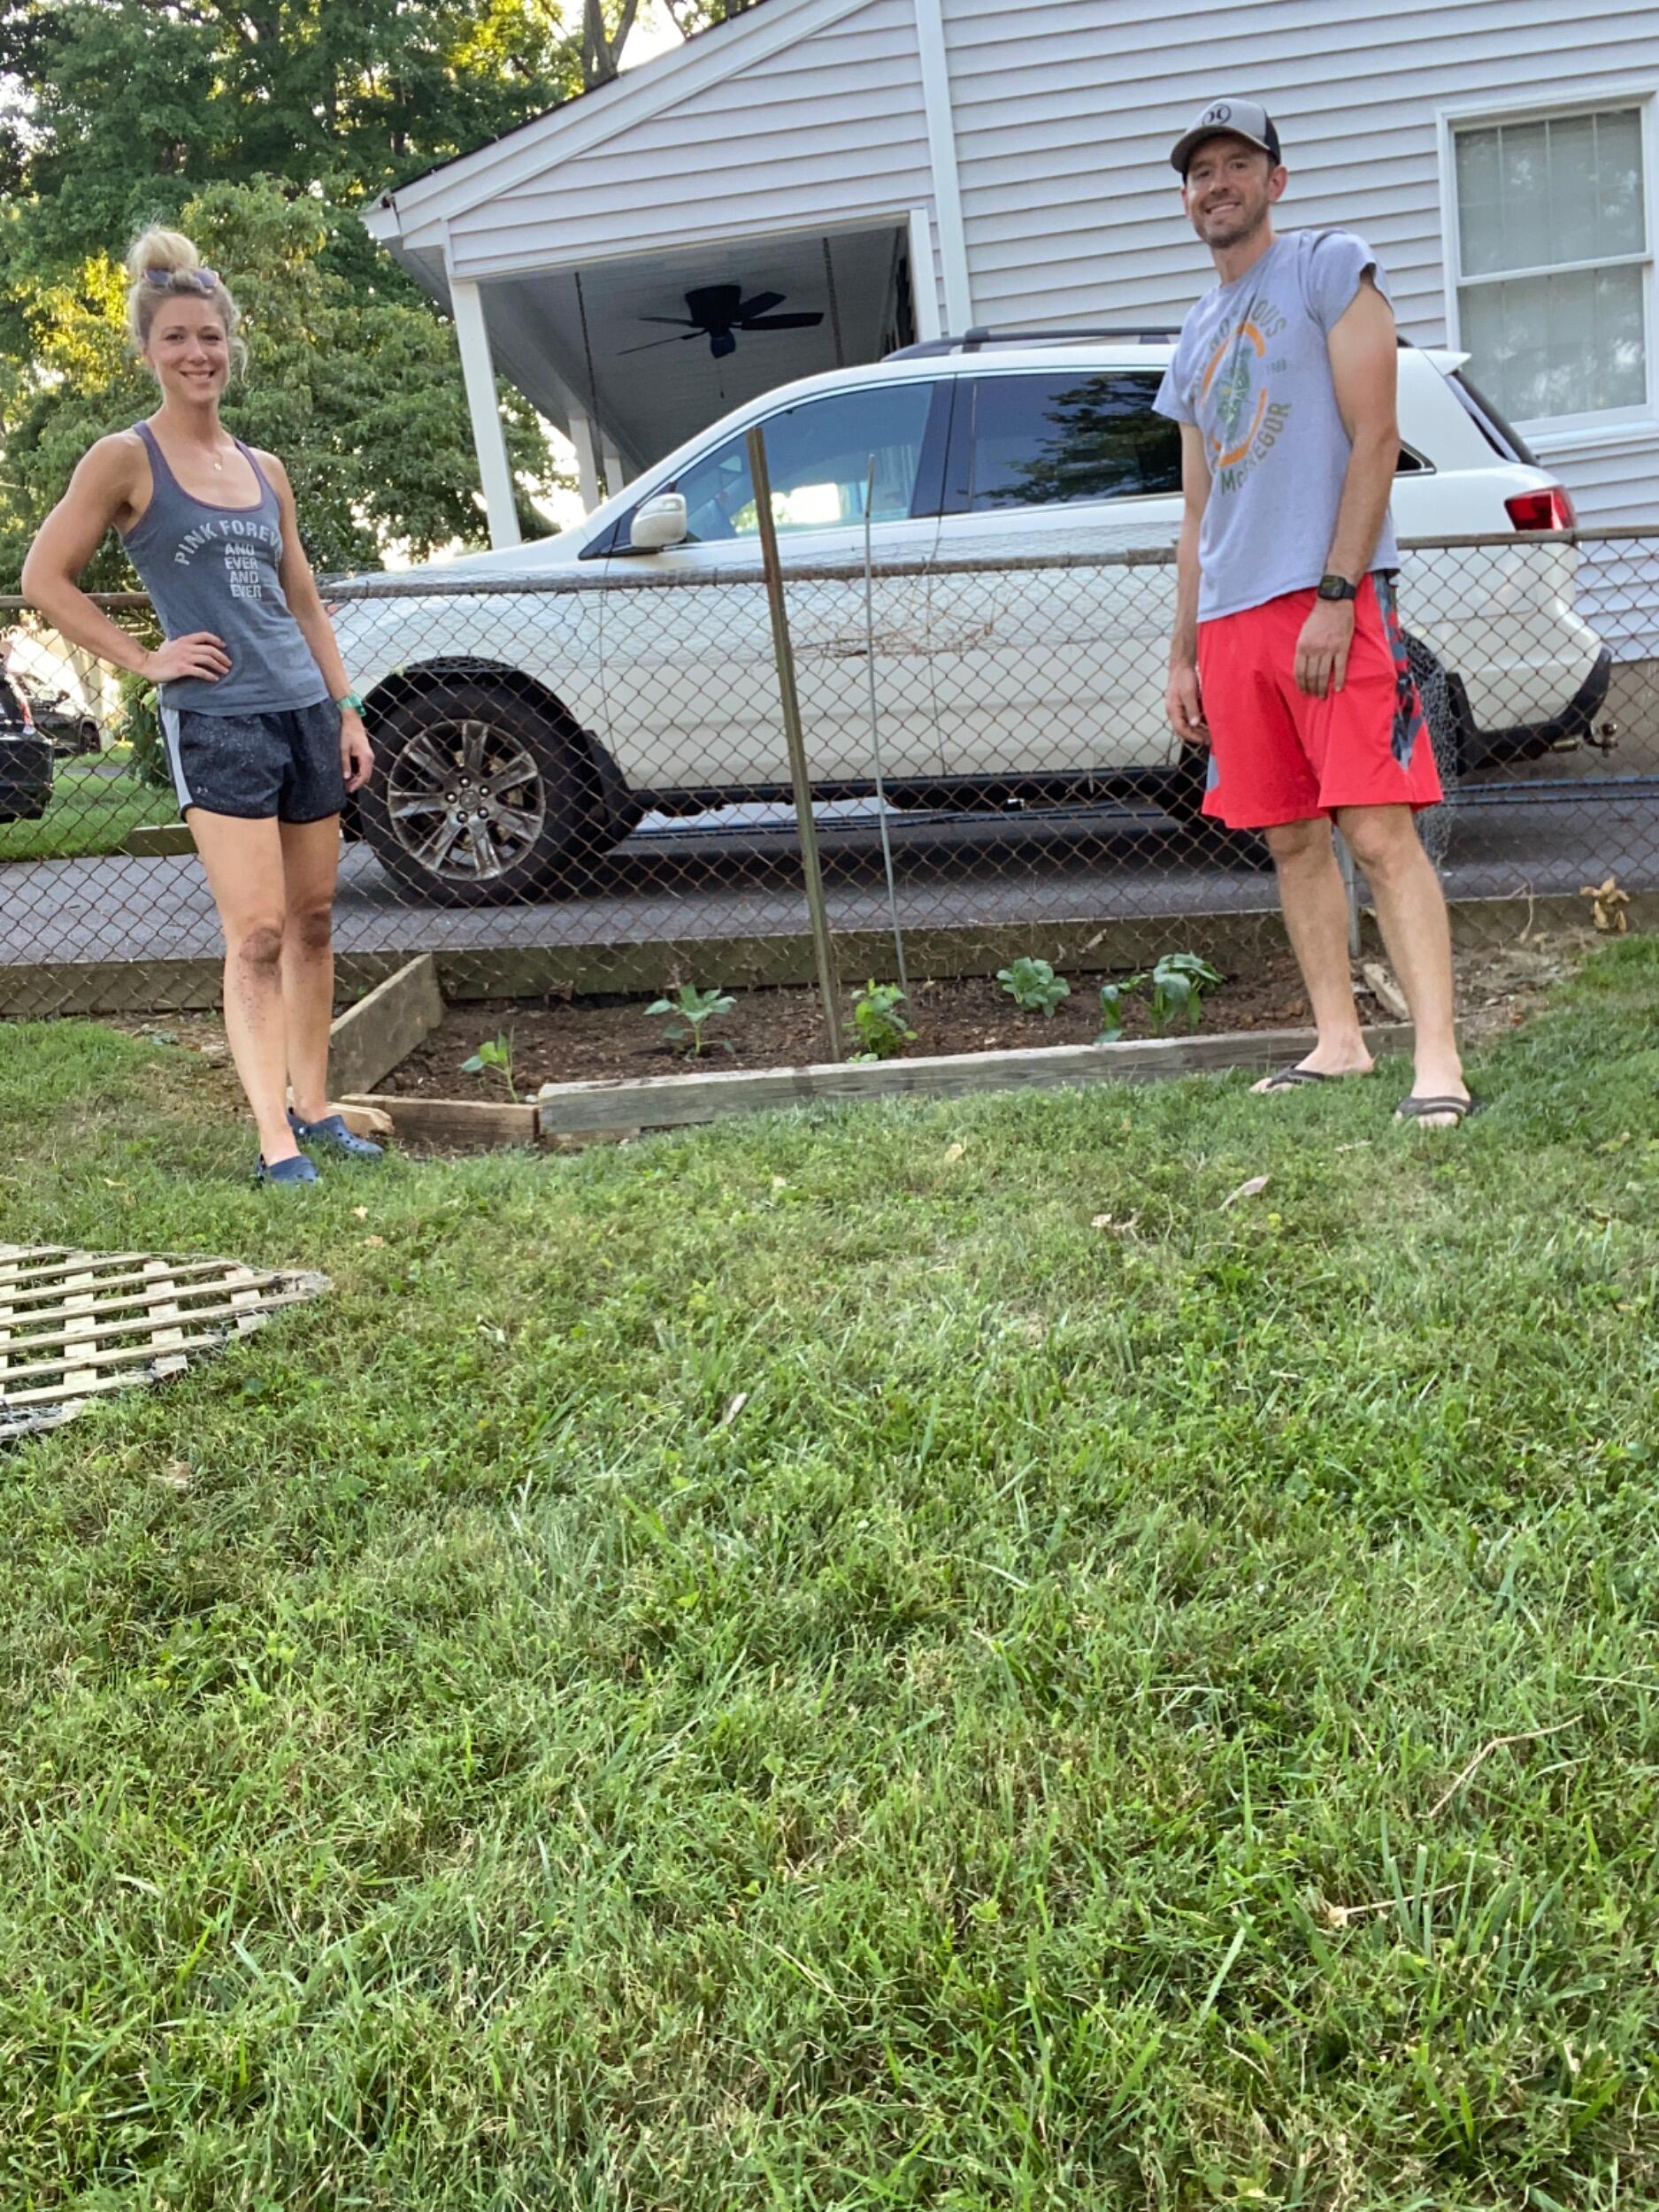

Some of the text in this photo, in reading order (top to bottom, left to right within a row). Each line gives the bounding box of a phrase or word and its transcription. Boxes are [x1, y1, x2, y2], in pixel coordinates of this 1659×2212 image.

[174, 519, 280, 565] PINK FOREV
[226, 542, 255, 556] AND
[225, 557, 258, 570] EVER
[230, 571, 258, 584] AND
[230, 584, 262, 598] EVER
